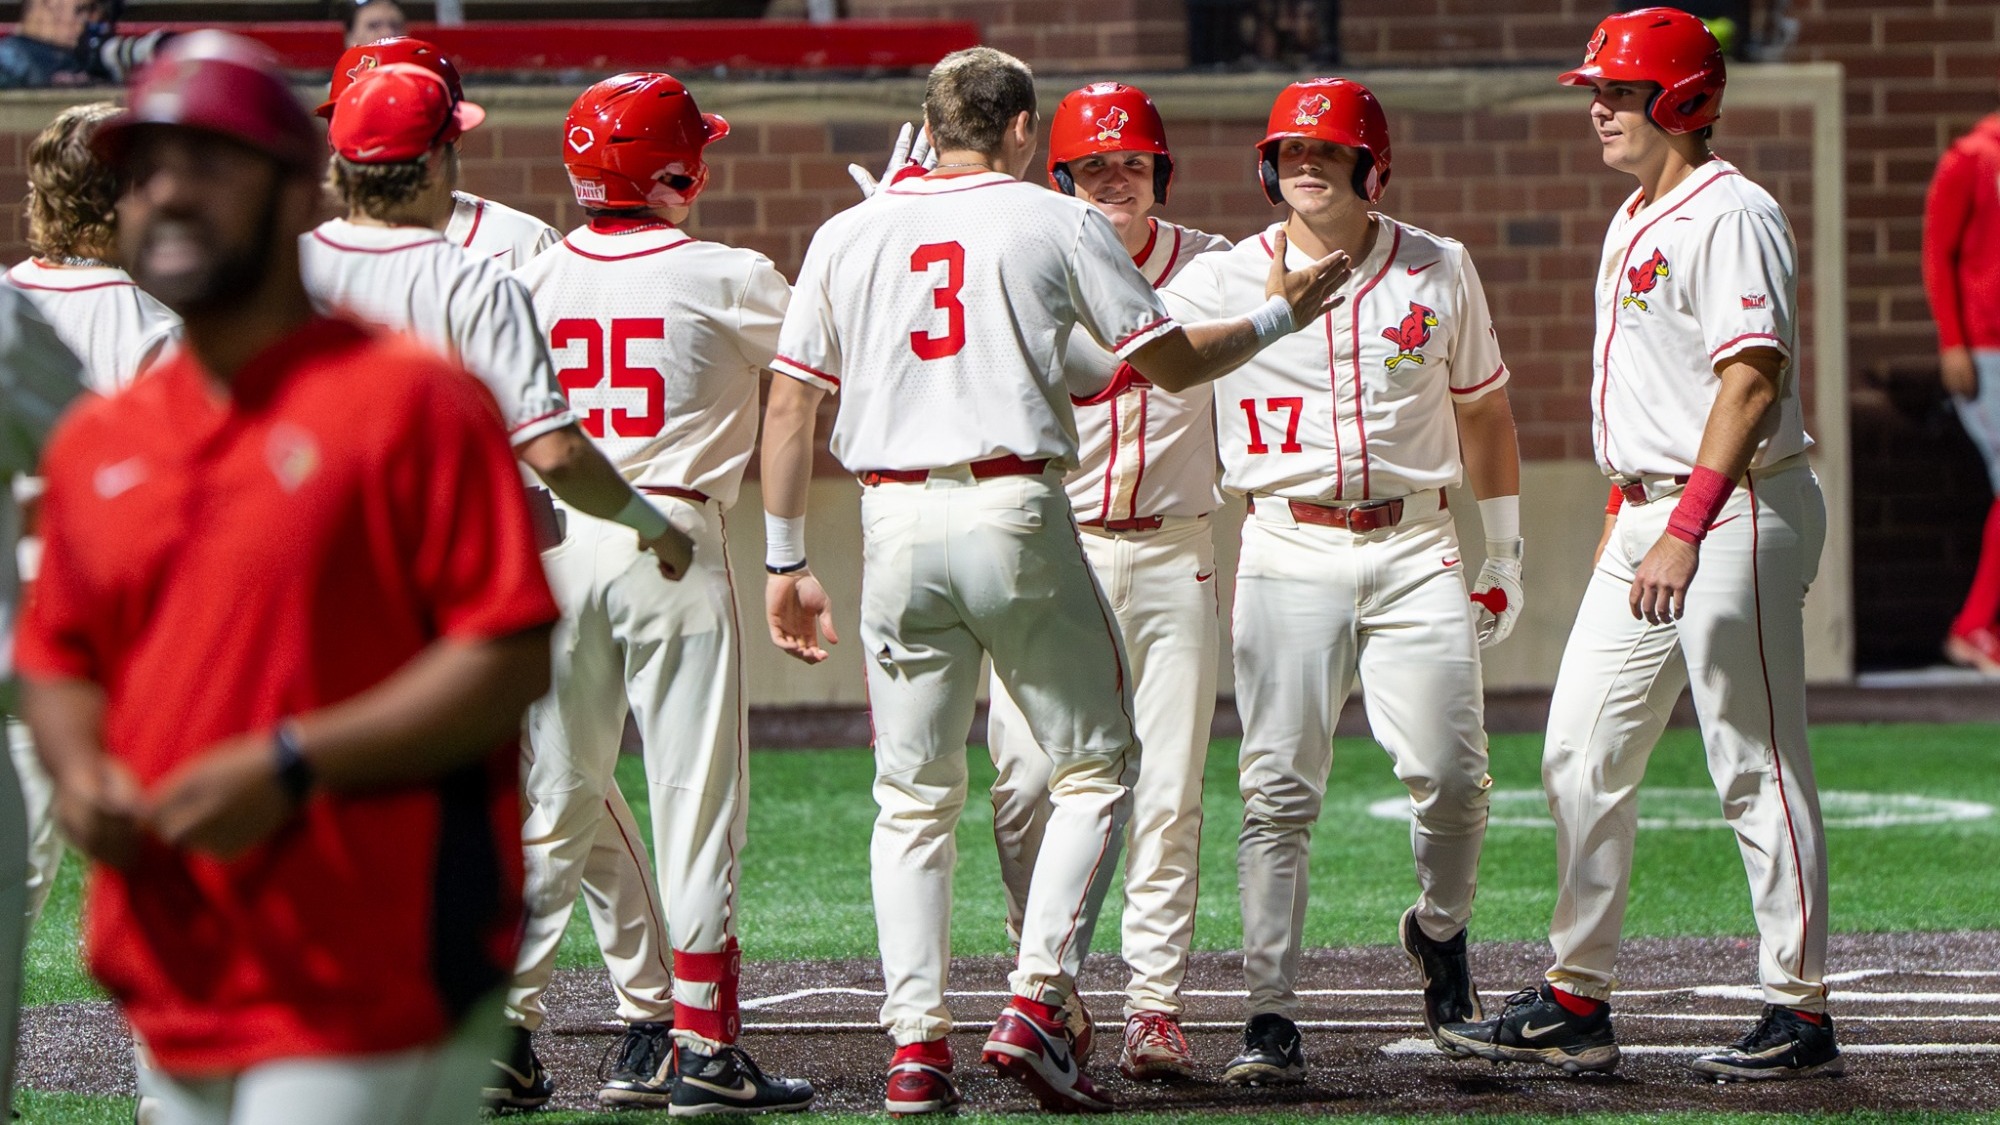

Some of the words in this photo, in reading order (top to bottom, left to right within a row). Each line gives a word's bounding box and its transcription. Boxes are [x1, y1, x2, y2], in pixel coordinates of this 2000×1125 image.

[576, 185, 605, 199] VALLEY
[910, 240, 965, 361] 3
[551, 318, 665, 438] 25
[1240, 397, 1303, 454] 17
